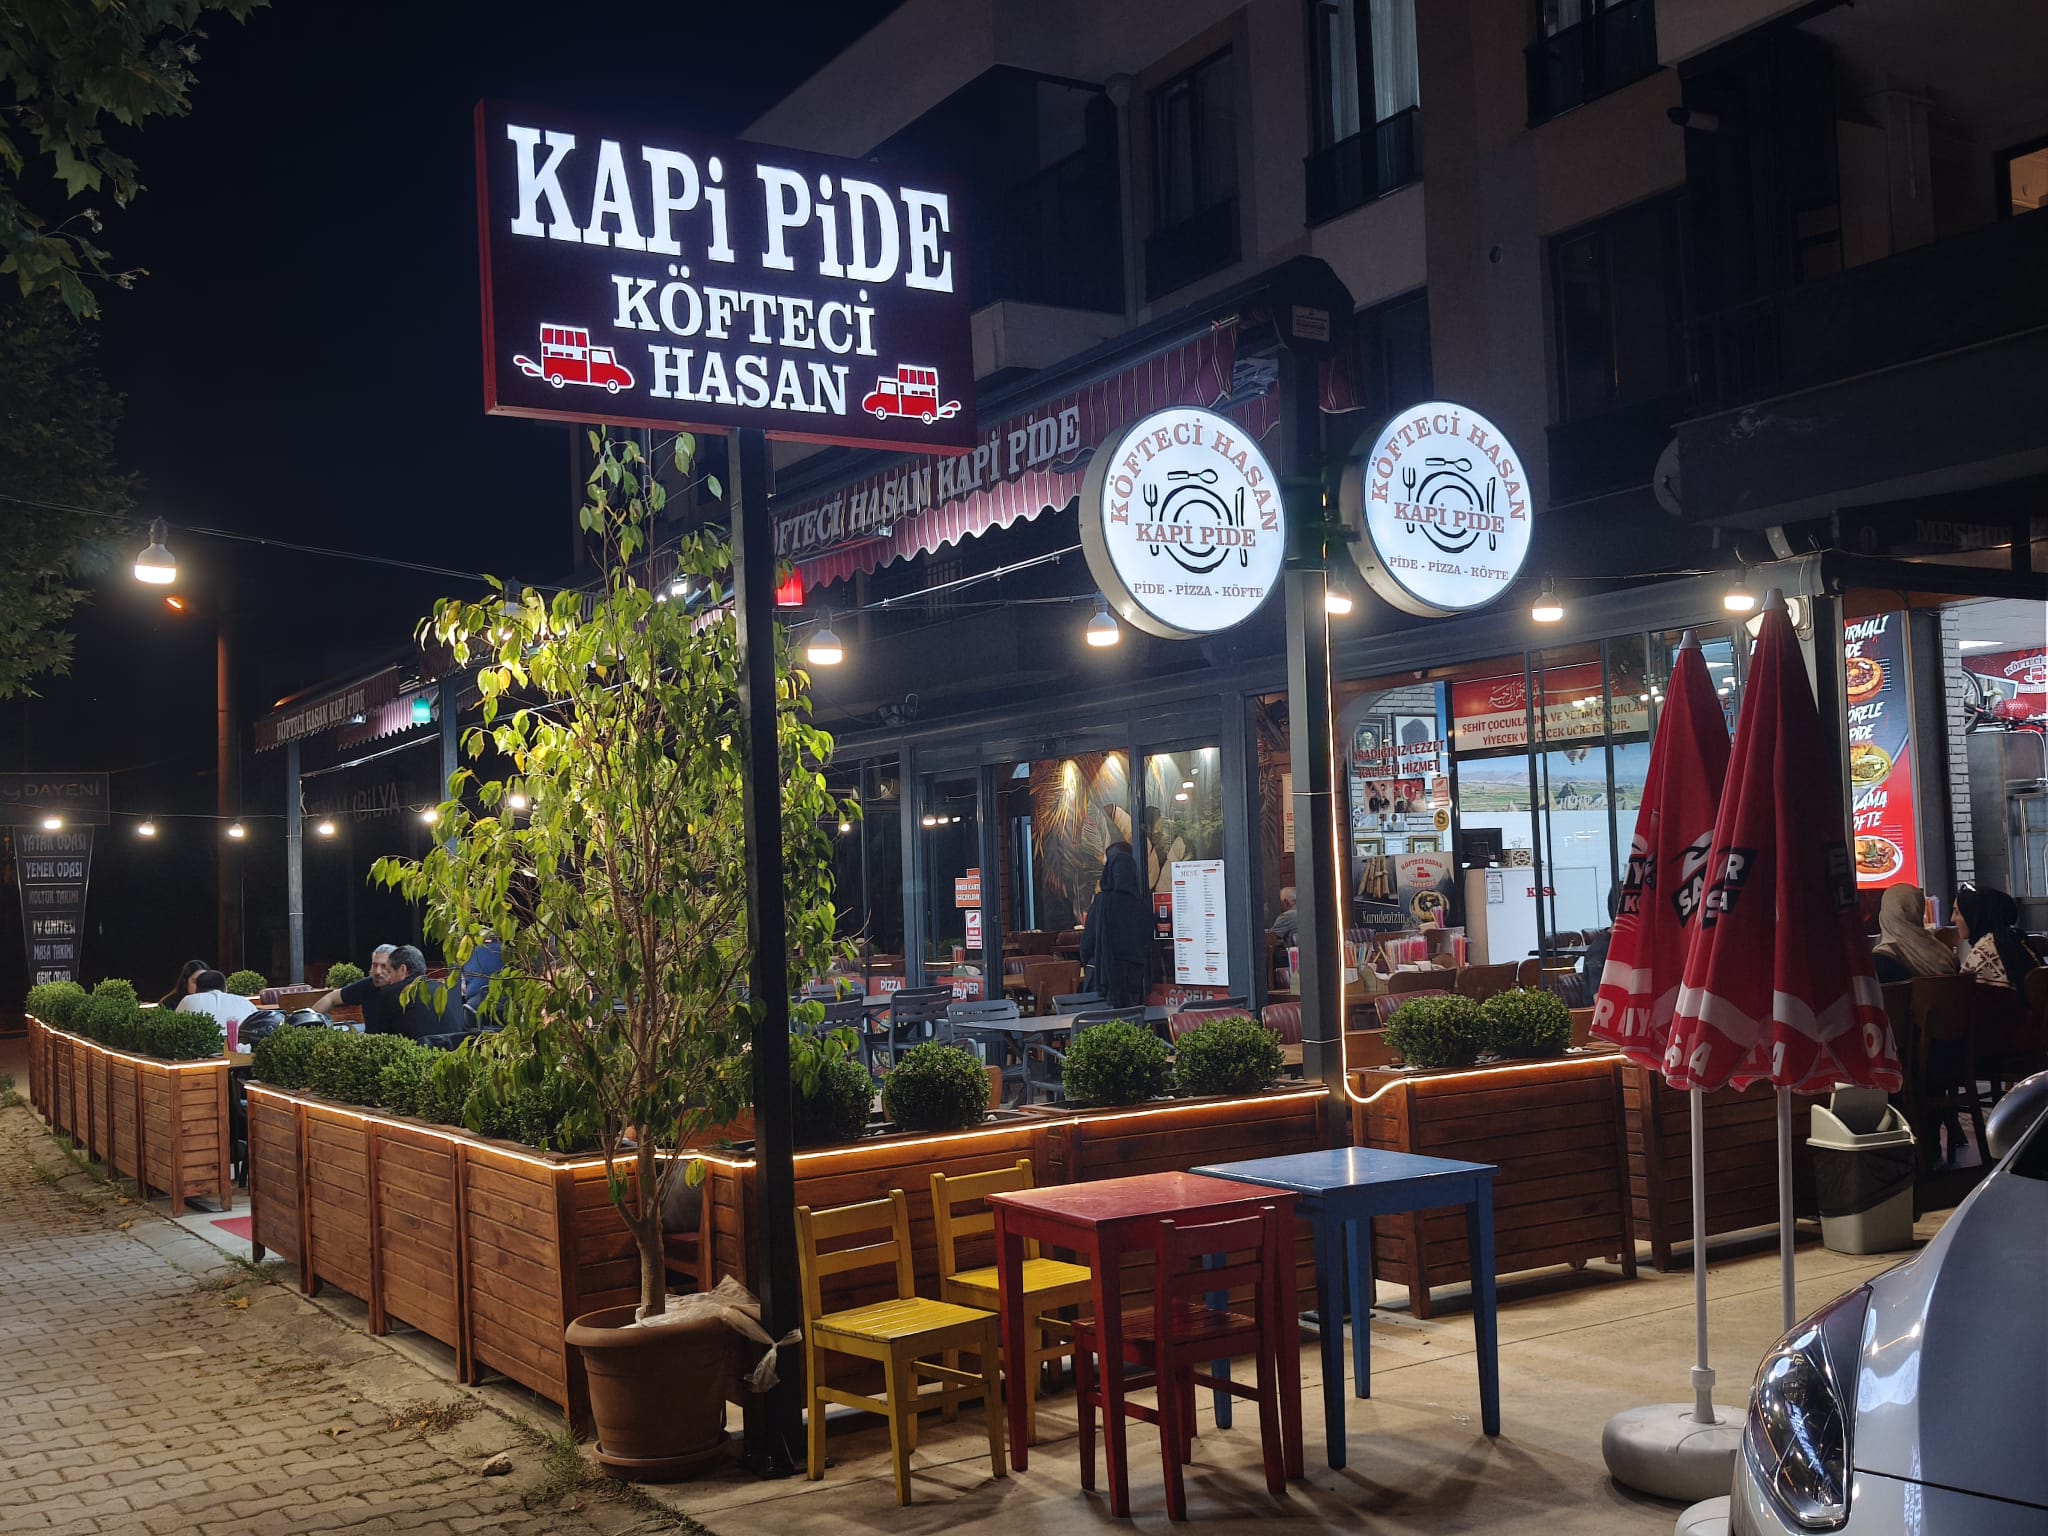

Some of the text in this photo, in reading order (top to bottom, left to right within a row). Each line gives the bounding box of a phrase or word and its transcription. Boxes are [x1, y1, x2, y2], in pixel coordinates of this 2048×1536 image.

[611, 264, 877, 356] KÖFTECİ
[649, 344, 849, 416] HASAN
[847, 470, 930, 529] HASAN
[936, 430, 1000, 500] KAPİ
[1007, 405, 1081, 474] PİDE
[1108, 418, 1278, 533] KÖFTECİ HASAN
[1370, 411, 1527, 522] KÖFTECİ HASAN
[1453, 505, 1505, 534] PİDE
[1200, 519, 1256, 549] PİDE
[1389, 555, 1510, 582] PİDE PİZZA KÖFTE
[1134, 581, 1264, 599] PİDE PİZZA KÖFTE
[1462, 720, 1487, 736] ŞEHİT
[1488, 714, 1549, 735] ÇOCUKLAINA
[1550, 711, 1563, 723] VE
[1409, 740, 1445, 755] LEZZET
[1482, 732, 1518, 746] YİYECEK
[1402, 759, 1441, 775] HİZMET
[26, 862, 83, 879] YEMEK ODASI
[1526, 886, 1558, 897] KSA
[33, 944, 74, 961] MASA TAKIMI
[880, 977, 902, 991] PİZZA
